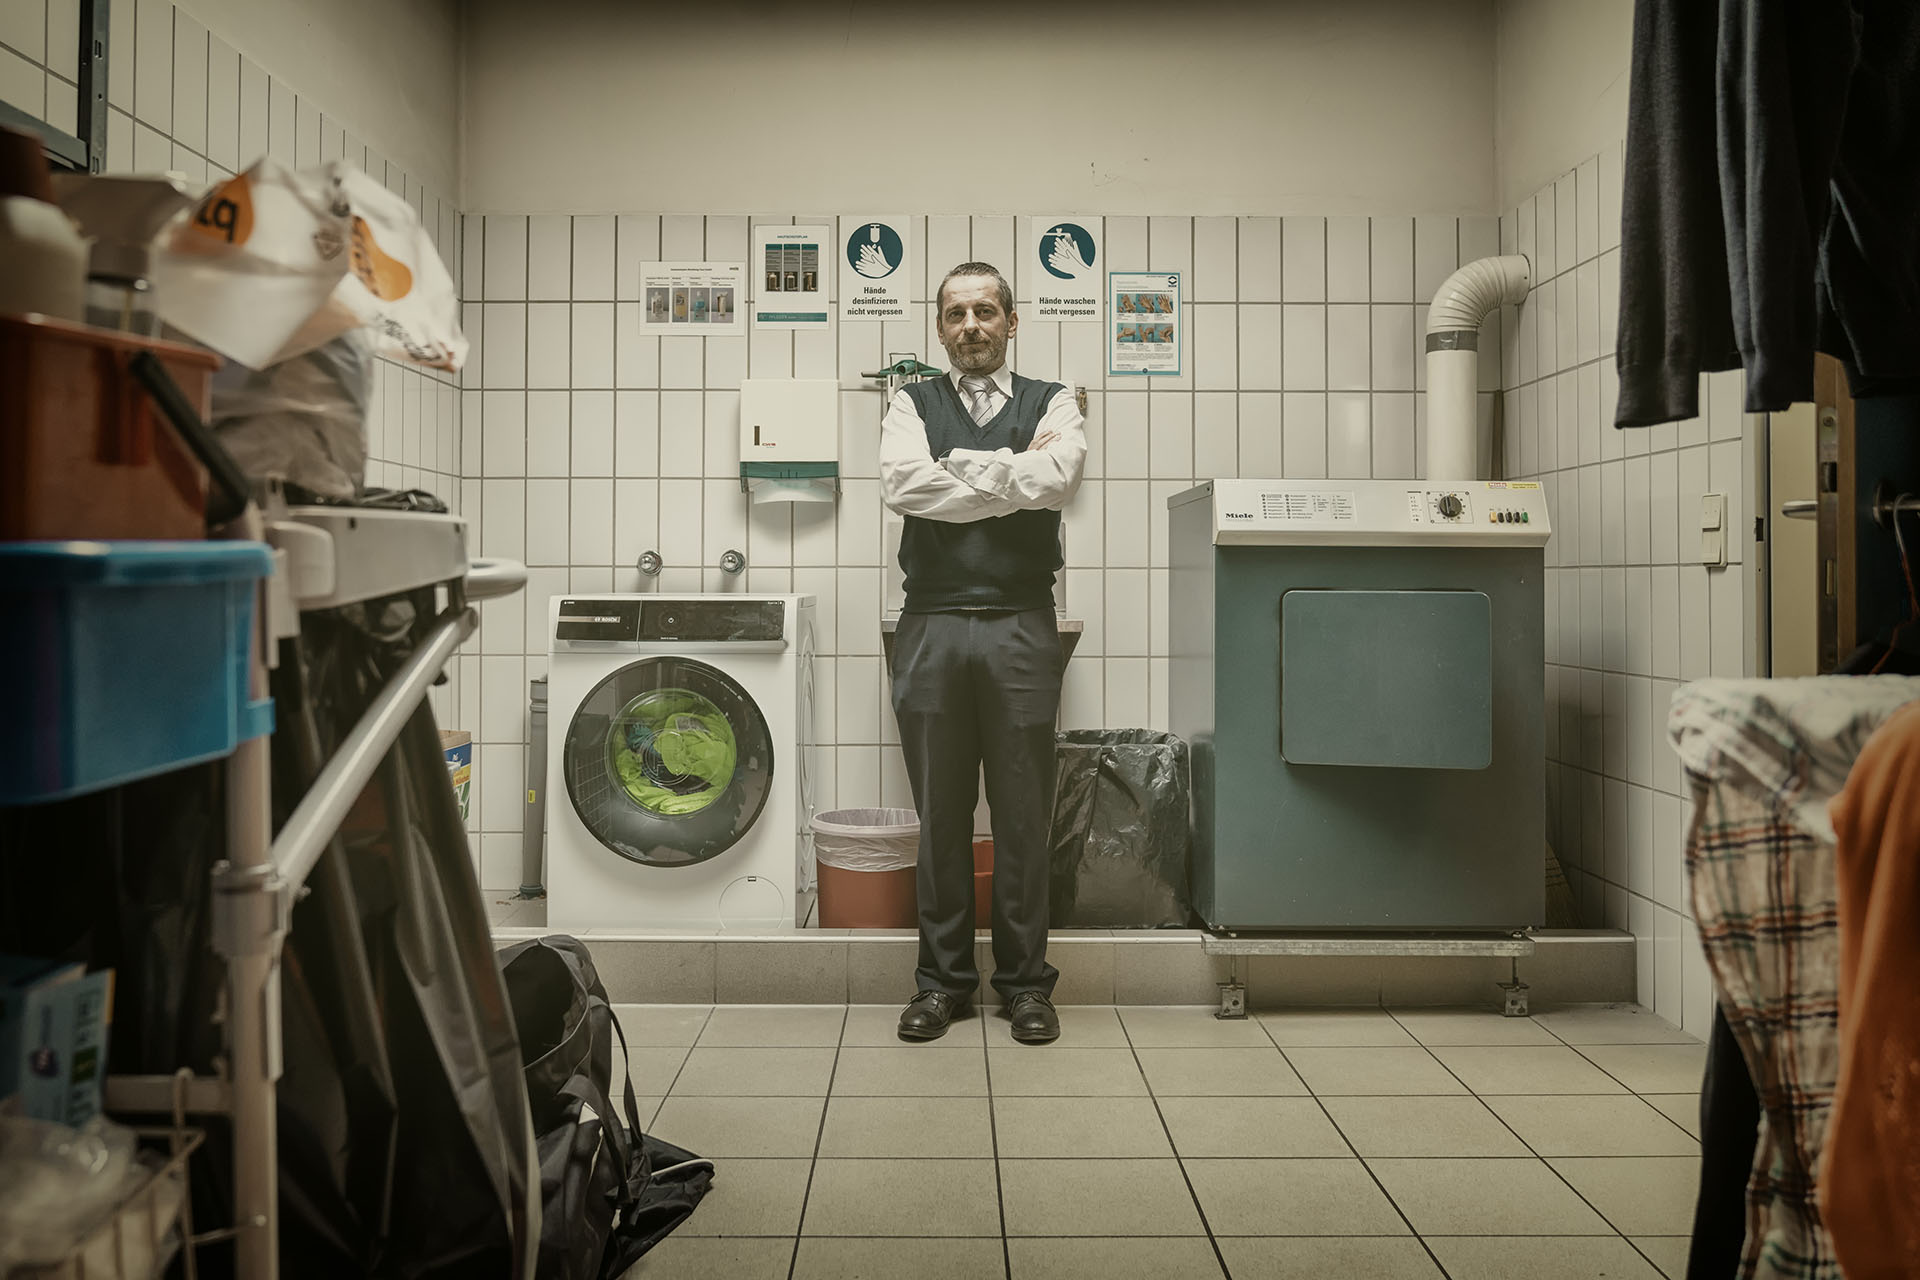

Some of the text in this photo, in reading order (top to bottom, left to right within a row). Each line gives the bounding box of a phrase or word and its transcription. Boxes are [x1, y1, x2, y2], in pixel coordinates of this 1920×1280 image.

[864, 286, 886, 295] Hände
[852, 297, 898, 305] desinfizieren
[1039, 296, 1096, 305] Hände waschen
[847, 307, 903, 318] nicht vergessen
[1040, 307, 1096, 317] nicht vergessen
[1225, 512, 1254, 520] Miele
